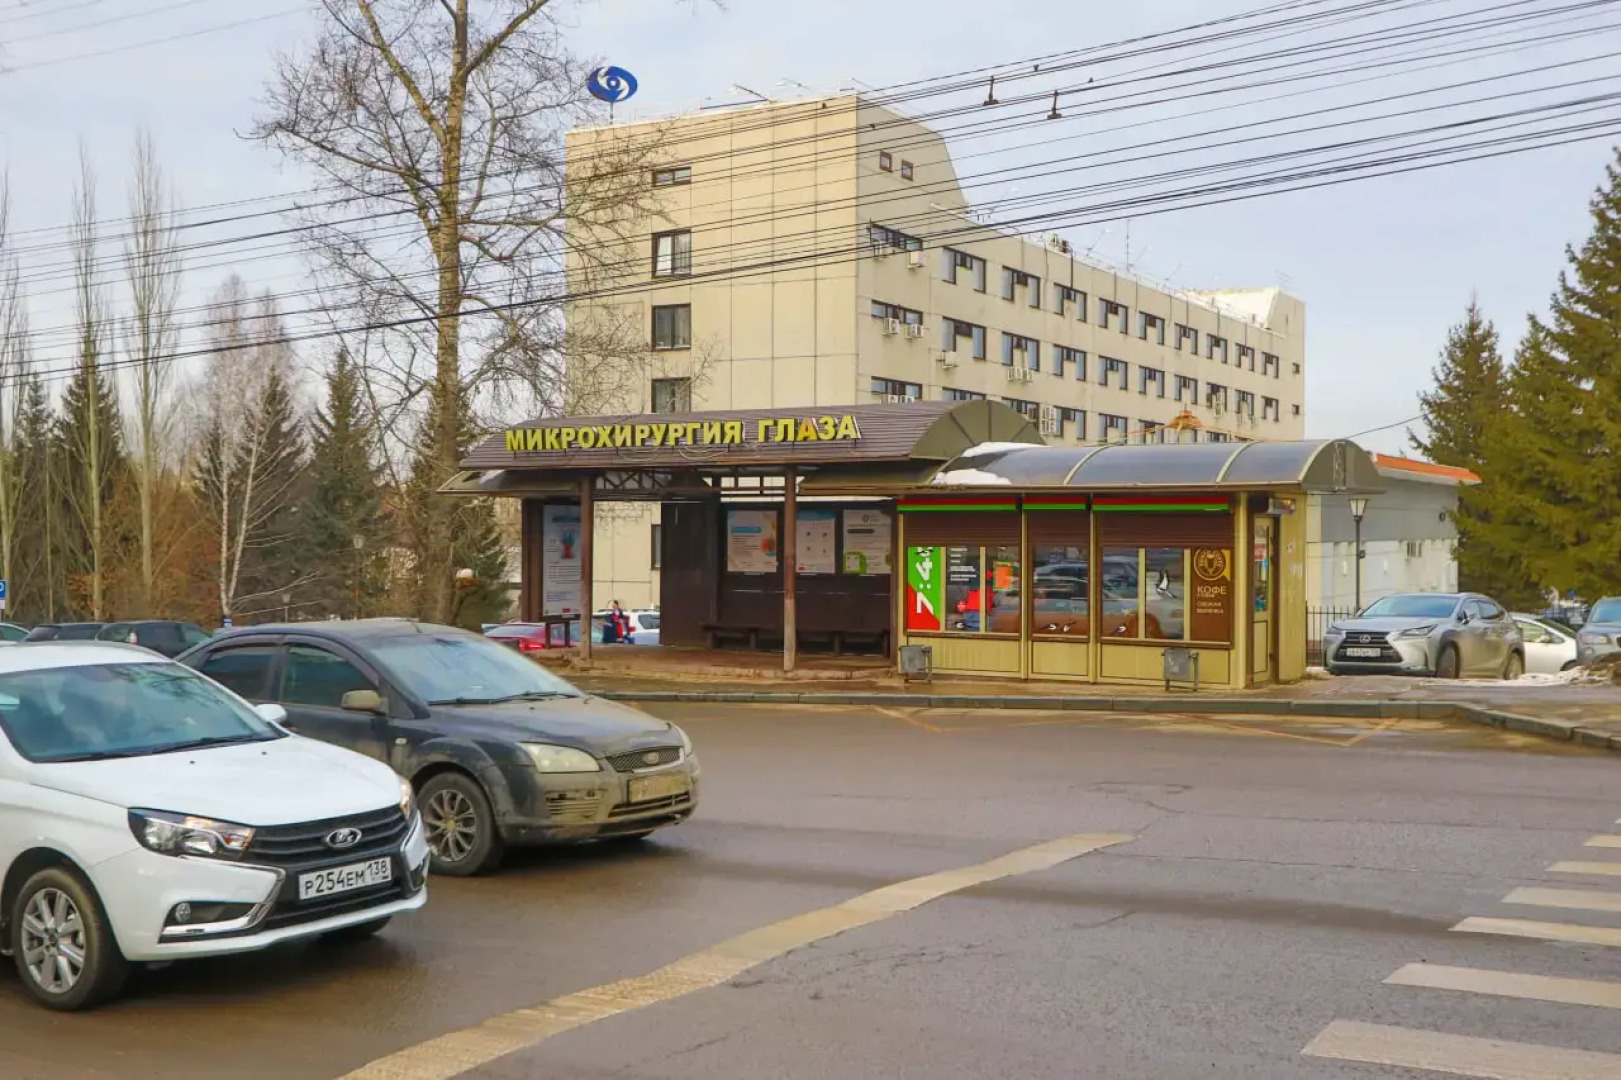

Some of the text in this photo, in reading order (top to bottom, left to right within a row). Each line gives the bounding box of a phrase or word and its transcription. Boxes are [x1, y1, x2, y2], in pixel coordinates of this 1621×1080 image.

[505, 414, 861, 451] МИКРОХИРУРГИЯ ГЛАЗА
[1197, 585, 1227, 595] КОФЕ
